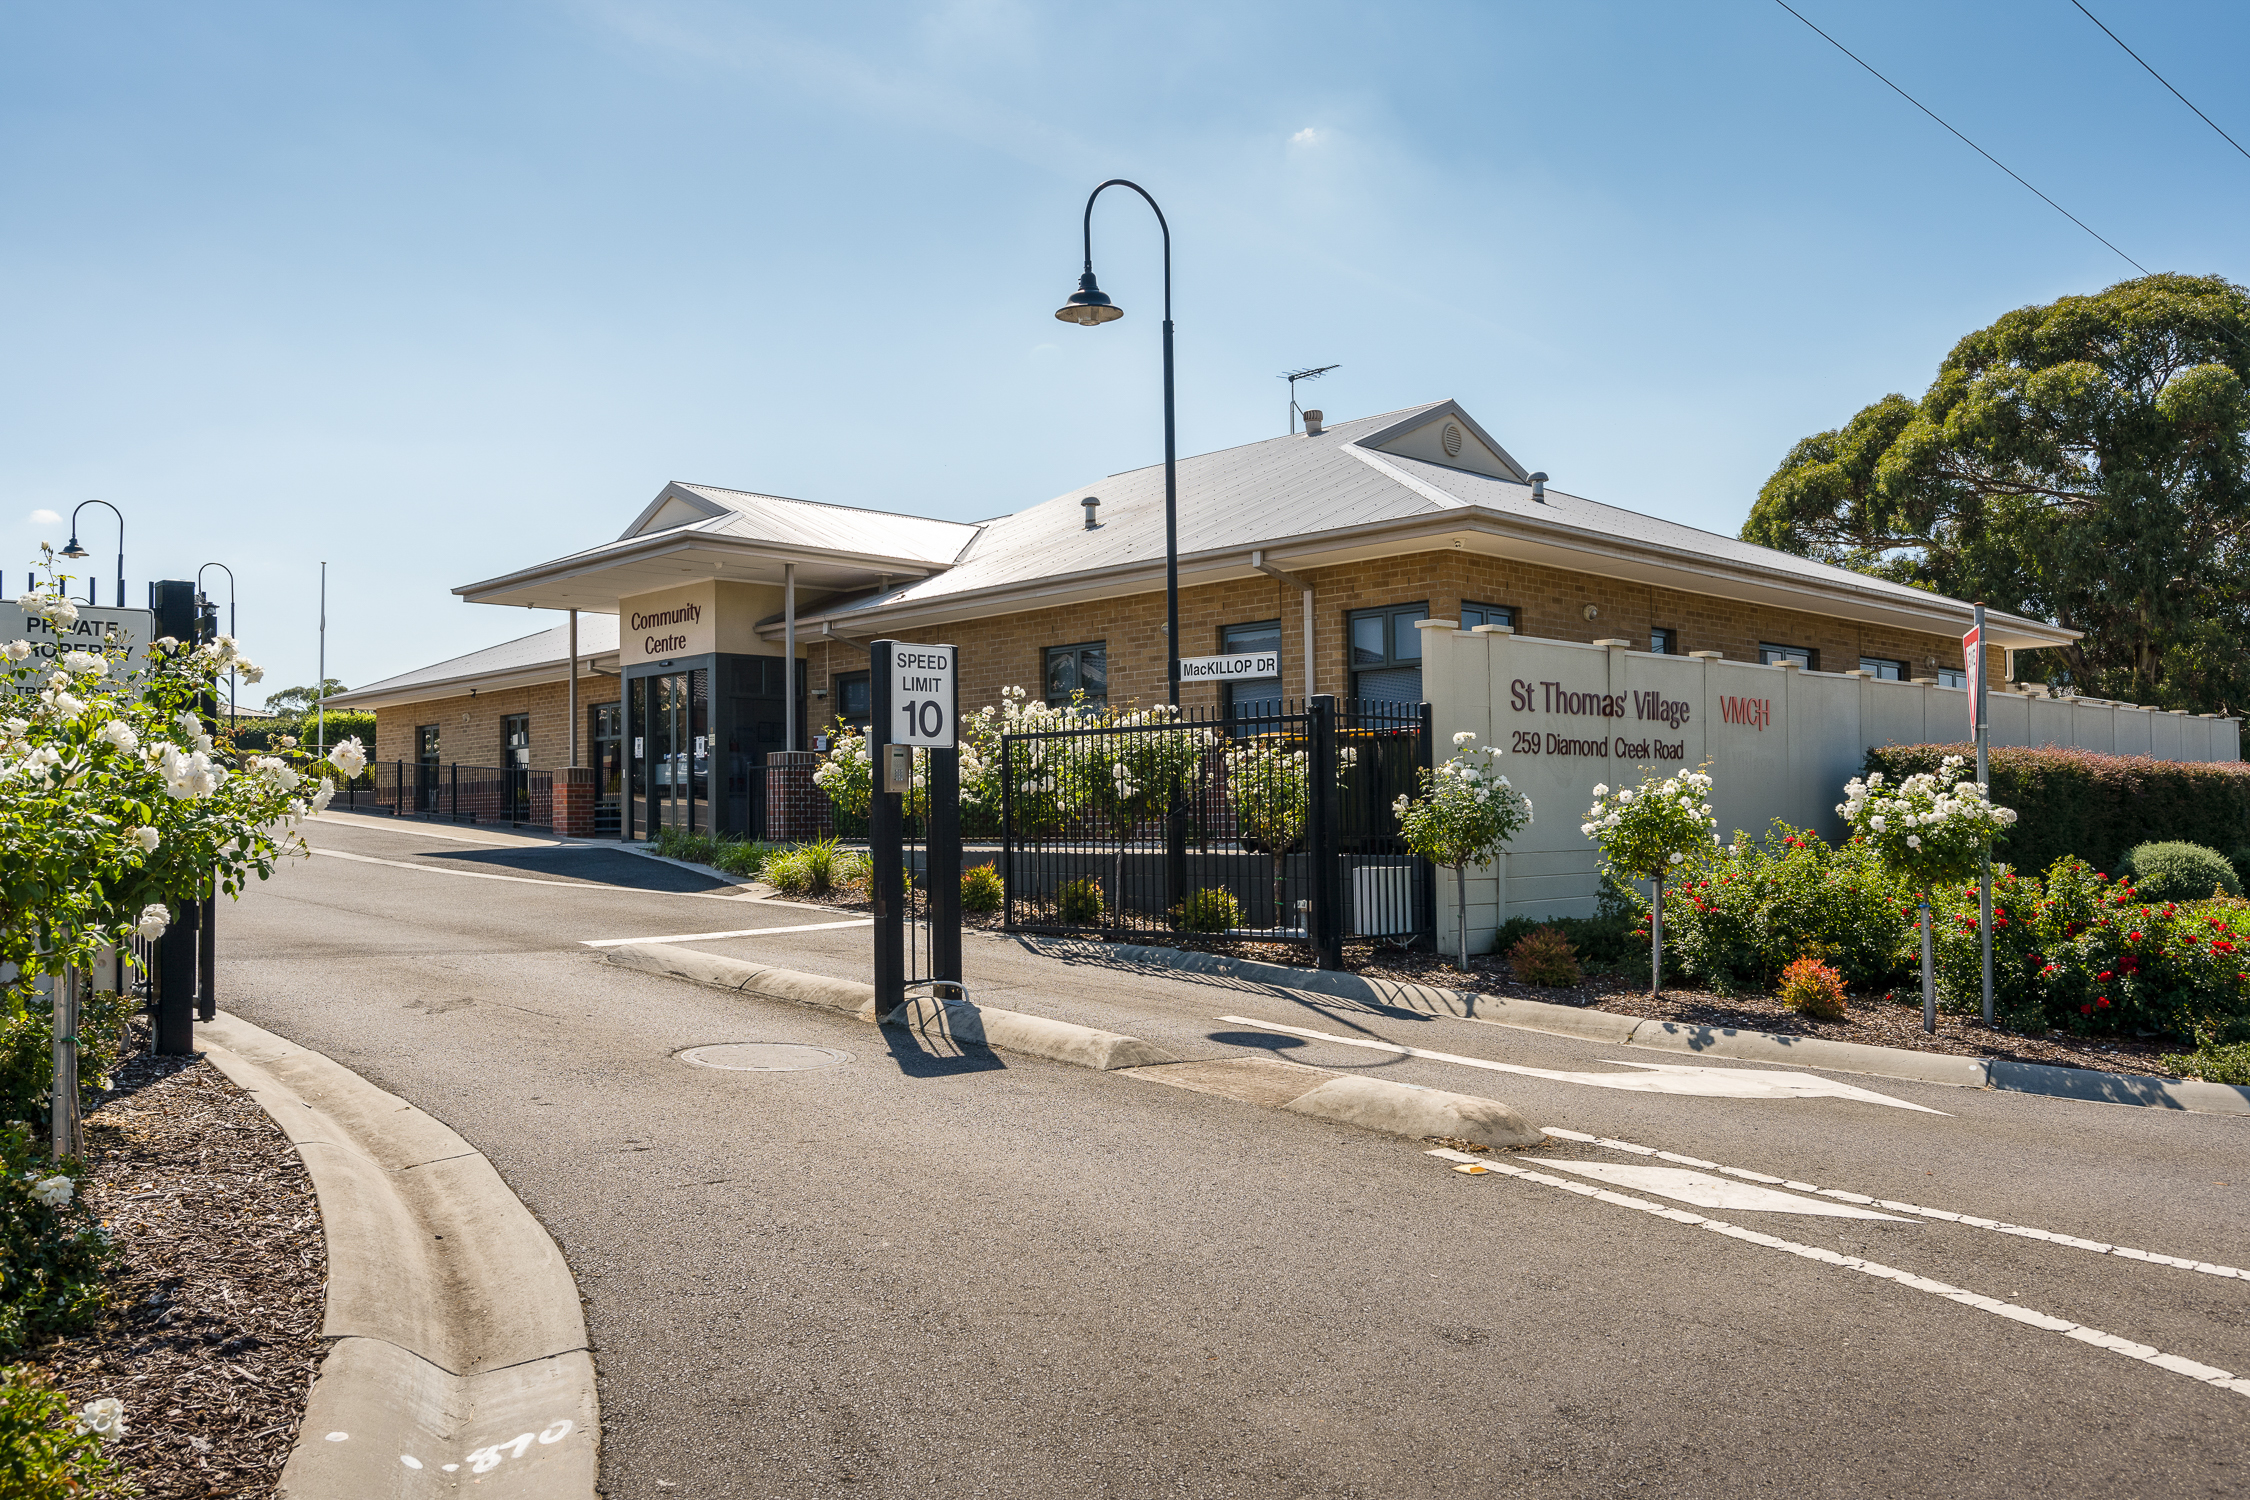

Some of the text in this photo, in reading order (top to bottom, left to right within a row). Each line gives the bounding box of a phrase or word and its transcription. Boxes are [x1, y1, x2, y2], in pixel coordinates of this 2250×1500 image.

[26, 616, 119, 638] PRVATE
[631, 602, 702, 631] Community
[645, 634, 687, 655] Centre
[897, 652, 948, 671] SPEED
[1183, 657, 1276, 677] MacKILLOP DR
[902, 676, 942, 693] LIMIT
[1510, 678, 1536, 713] St
[1633, 689, 1691, 730] Village
[1720, 695, 1770, 732] VMCH
[902, 700, 943, 738] 10
[1511, 730, 1684, 760] 259 Diamond Creek Road
